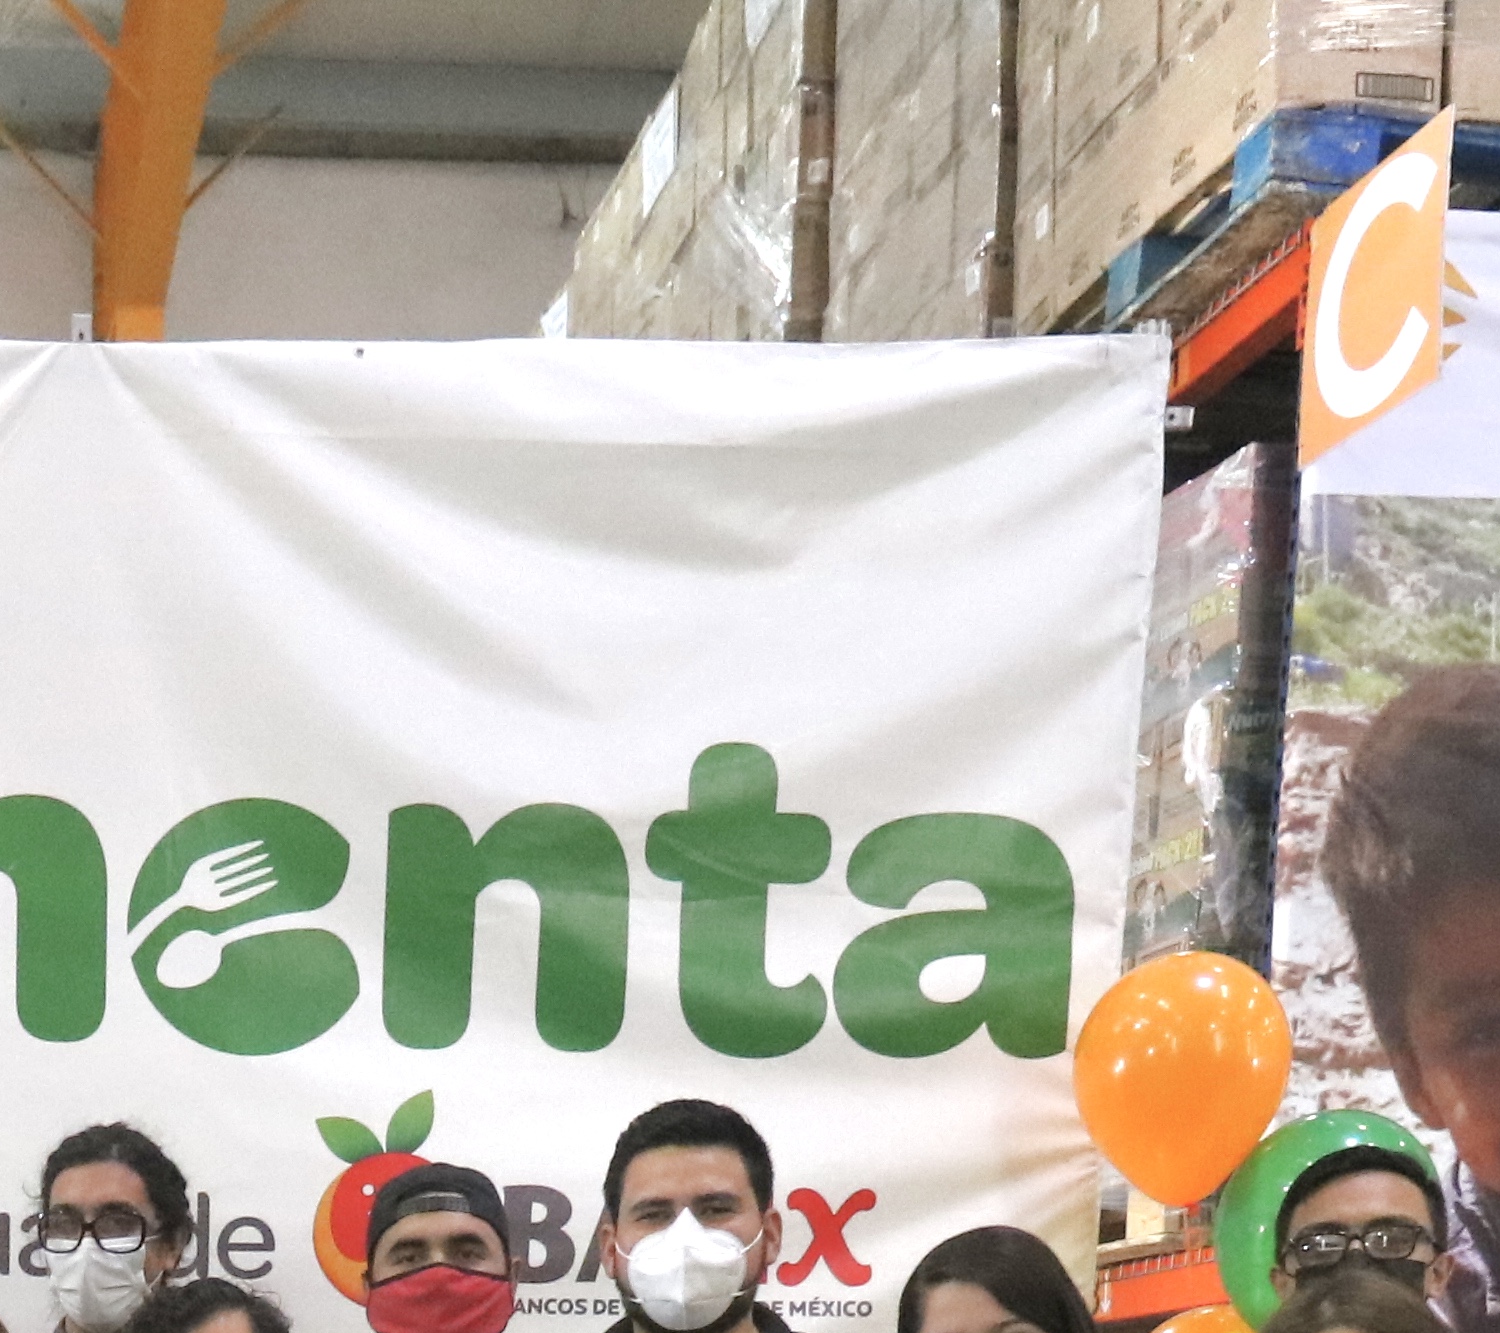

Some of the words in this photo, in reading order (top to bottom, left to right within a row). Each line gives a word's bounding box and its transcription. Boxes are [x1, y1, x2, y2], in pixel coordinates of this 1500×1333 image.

[1314, 152, 1438, 421] C
[513, 1297, 589, 1317] ANCOS
[593, 1297, 621, 1316] DE
[790, 1296, 873, 1318] MÉXICO
